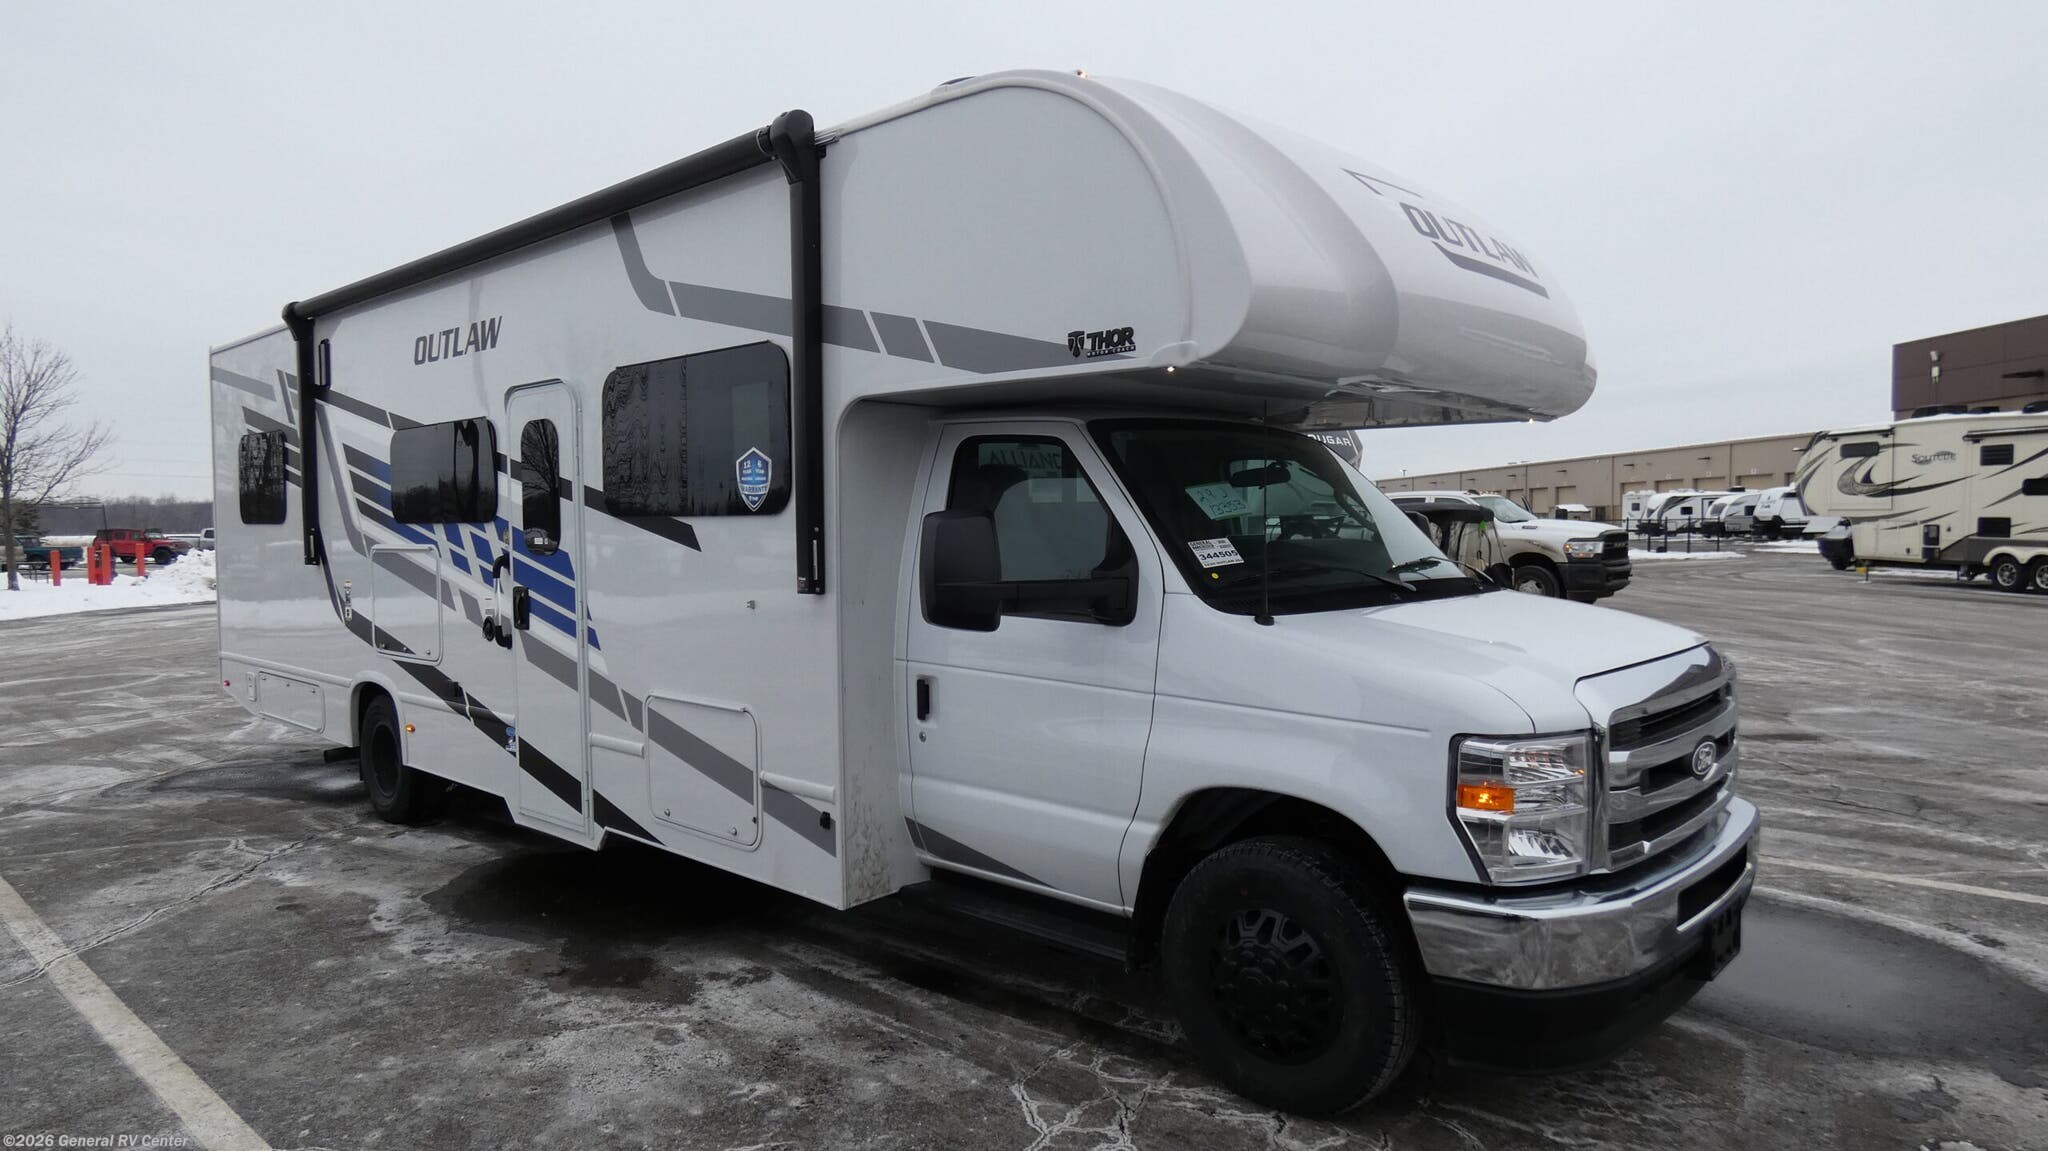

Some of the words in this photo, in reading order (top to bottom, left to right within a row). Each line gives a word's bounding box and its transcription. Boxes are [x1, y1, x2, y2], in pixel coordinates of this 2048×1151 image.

[1399, 202, 1539, 279] OUTLAW
[414, 315, 502, 365] OUTLAW
[1086, 326, 1135, 351] THOR
[1307, 434, 1351, 446] UGAR
[1199, 550, 1239, 561] 344505
